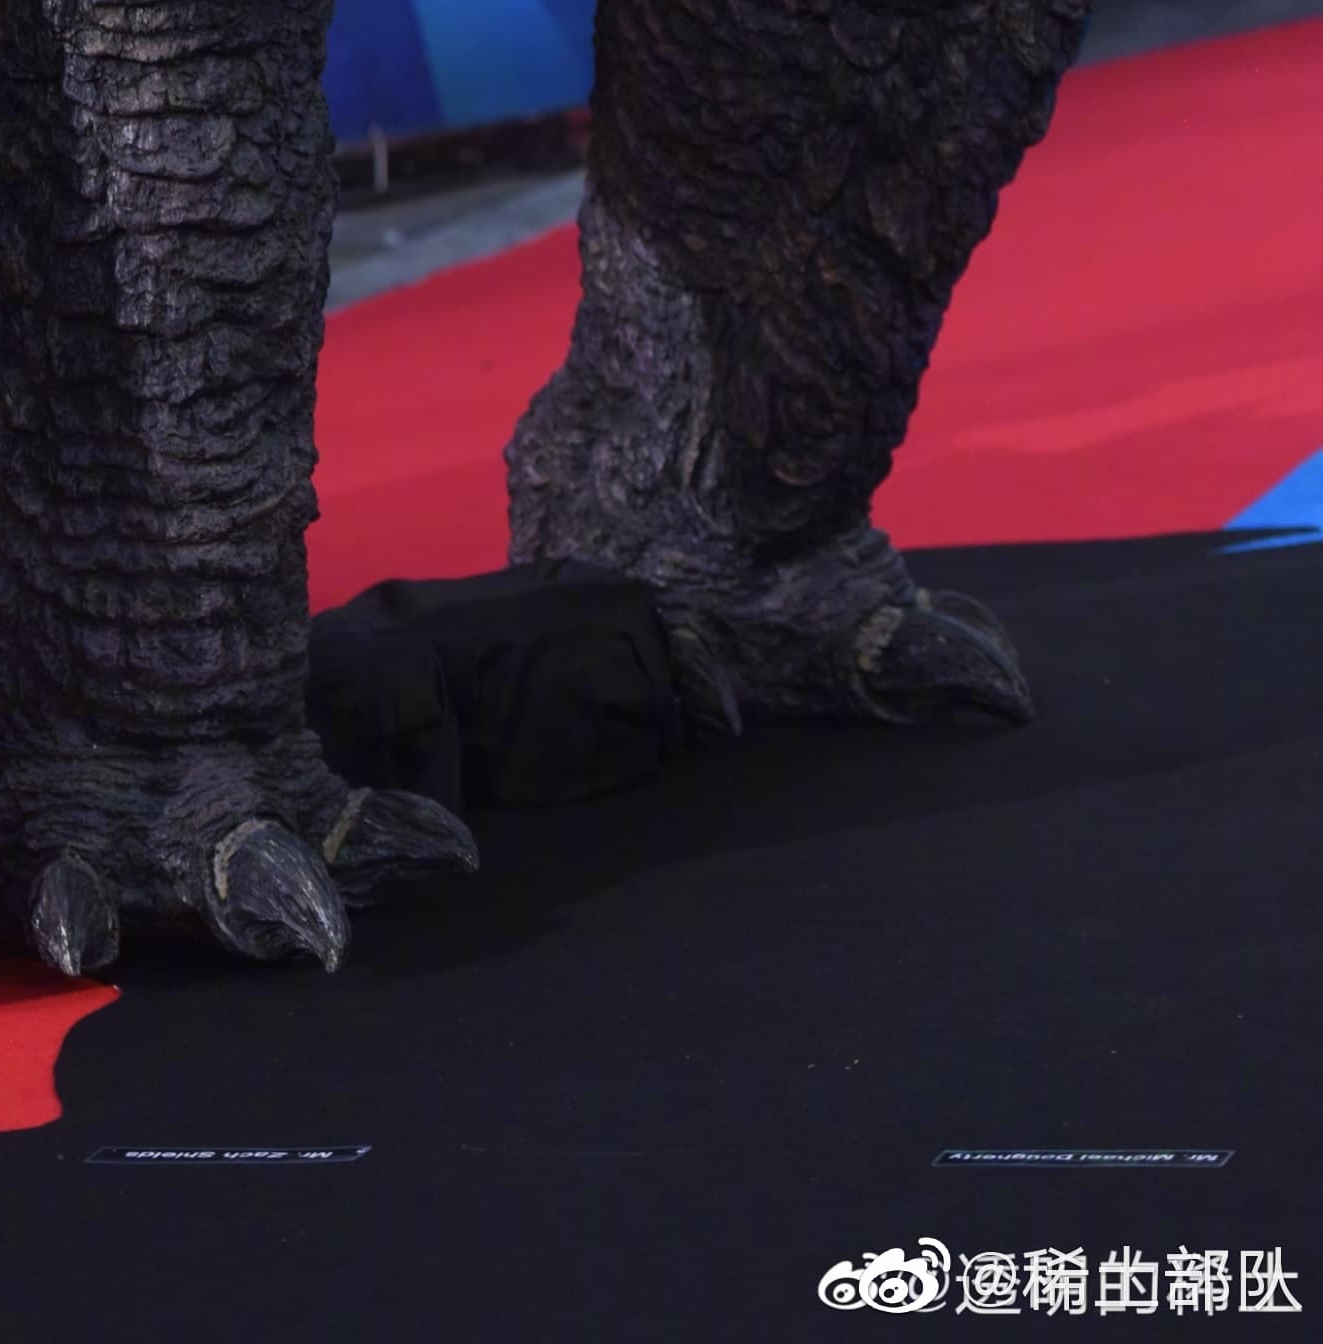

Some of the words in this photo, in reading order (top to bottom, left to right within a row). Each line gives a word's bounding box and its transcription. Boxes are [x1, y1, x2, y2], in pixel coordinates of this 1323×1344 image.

[125, 1151, 216, 1159] Shields
[223, 1151, 288, 1159] Zach
[948, 1152, 1074, 1161] Dougherty
[1078, 1153, 1175, 1161] Michael
